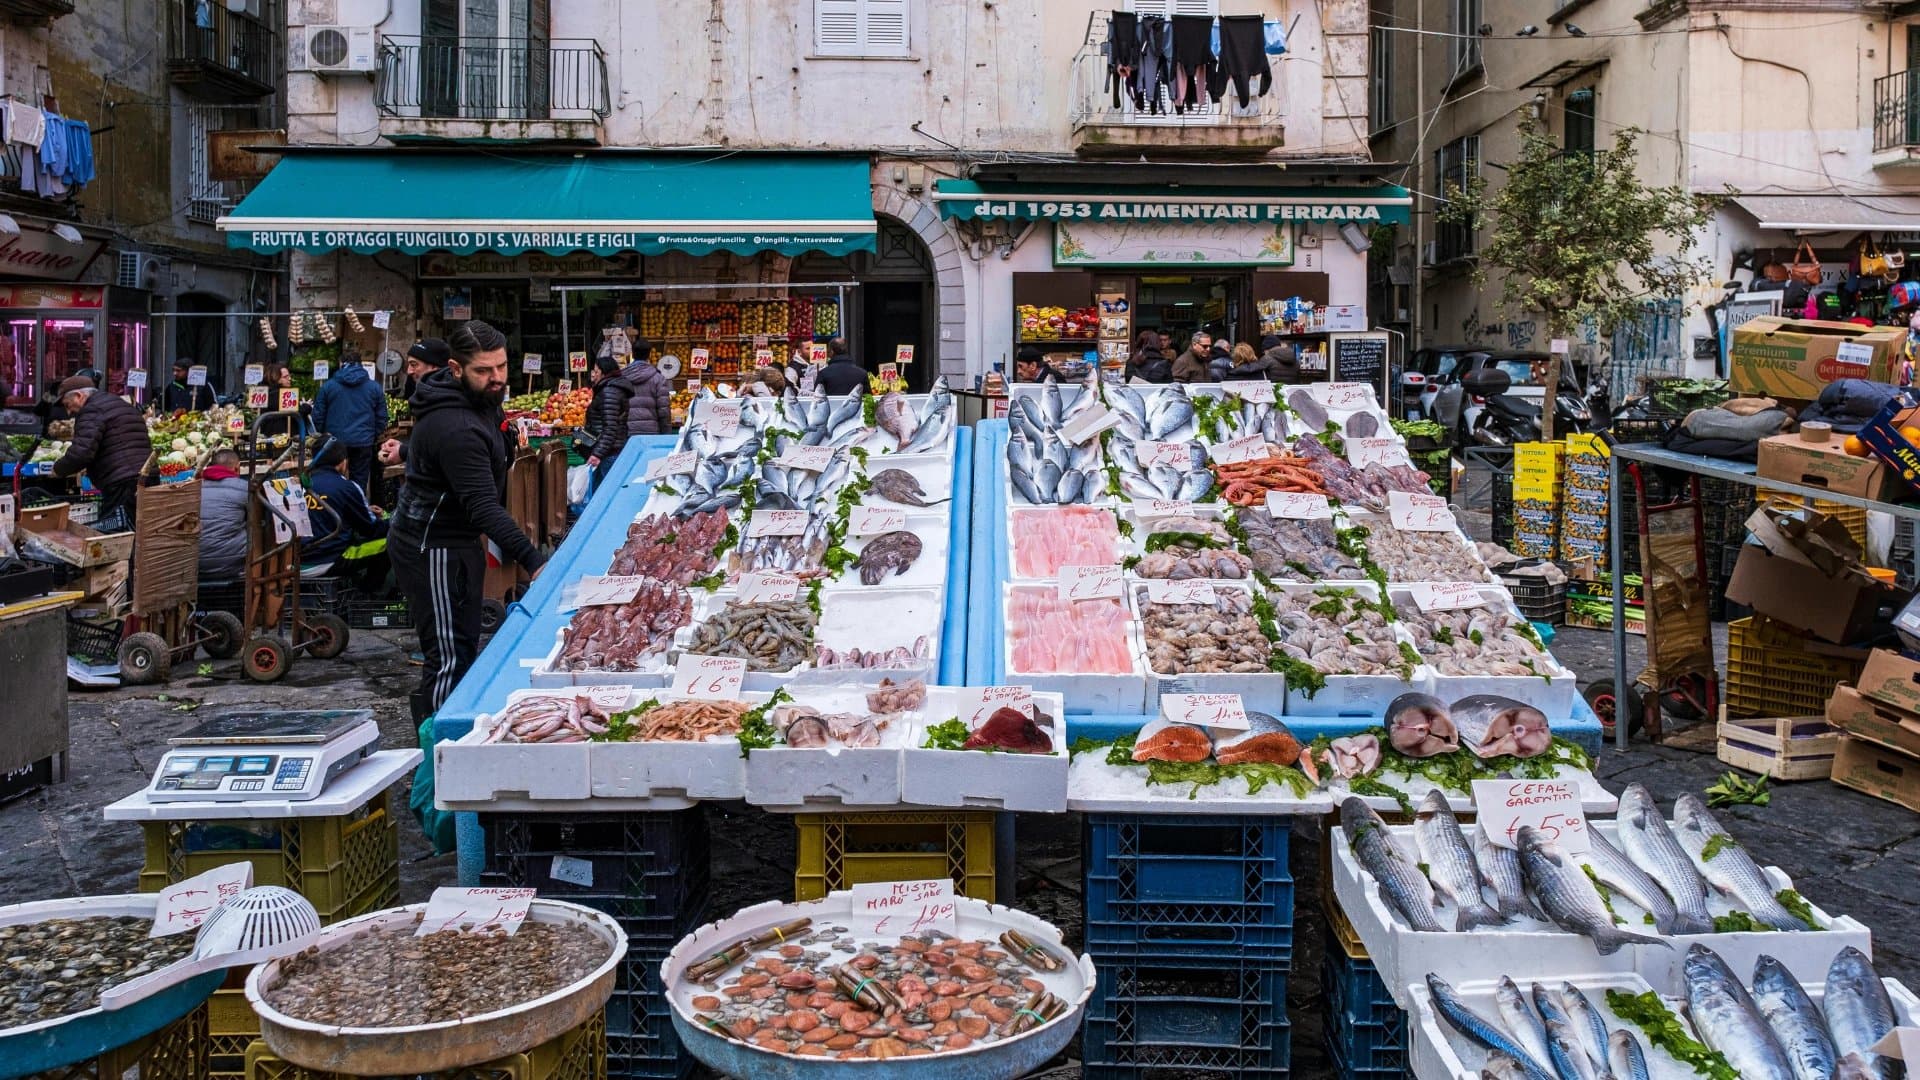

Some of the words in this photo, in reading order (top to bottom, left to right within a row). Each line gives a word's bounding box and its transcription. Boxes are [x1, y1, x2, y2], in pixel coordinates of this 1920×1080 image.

[974, 201, 1016, 216] dal
[1028, 203, 1091, 217] 1953
[1099, 203, 1257, 219] ALIMENTARI
[1267, 205, 1381, 219] FERRARA
[252, 232, 307, 247] FRUTTA
[312, 232, 321, 247] E
[325, 232, 391, 247] ORTAGGI
[396, 232, 469, 247] FUNGILLO
[475, 233, 492, 247] DI
[497, 233, 509, 247] S.
[512, 233, 582, 247] VARRIALE
[587, 233, 595, 248] E
[599, 233, 635, 247] FIGLI
[1736, 344, 1791, 358] Premium
[1735, 356, 1797, 372] BANANAS
[1819, 363, 1835, 374] Del
[1836, 365, 1866, 377] Monte
